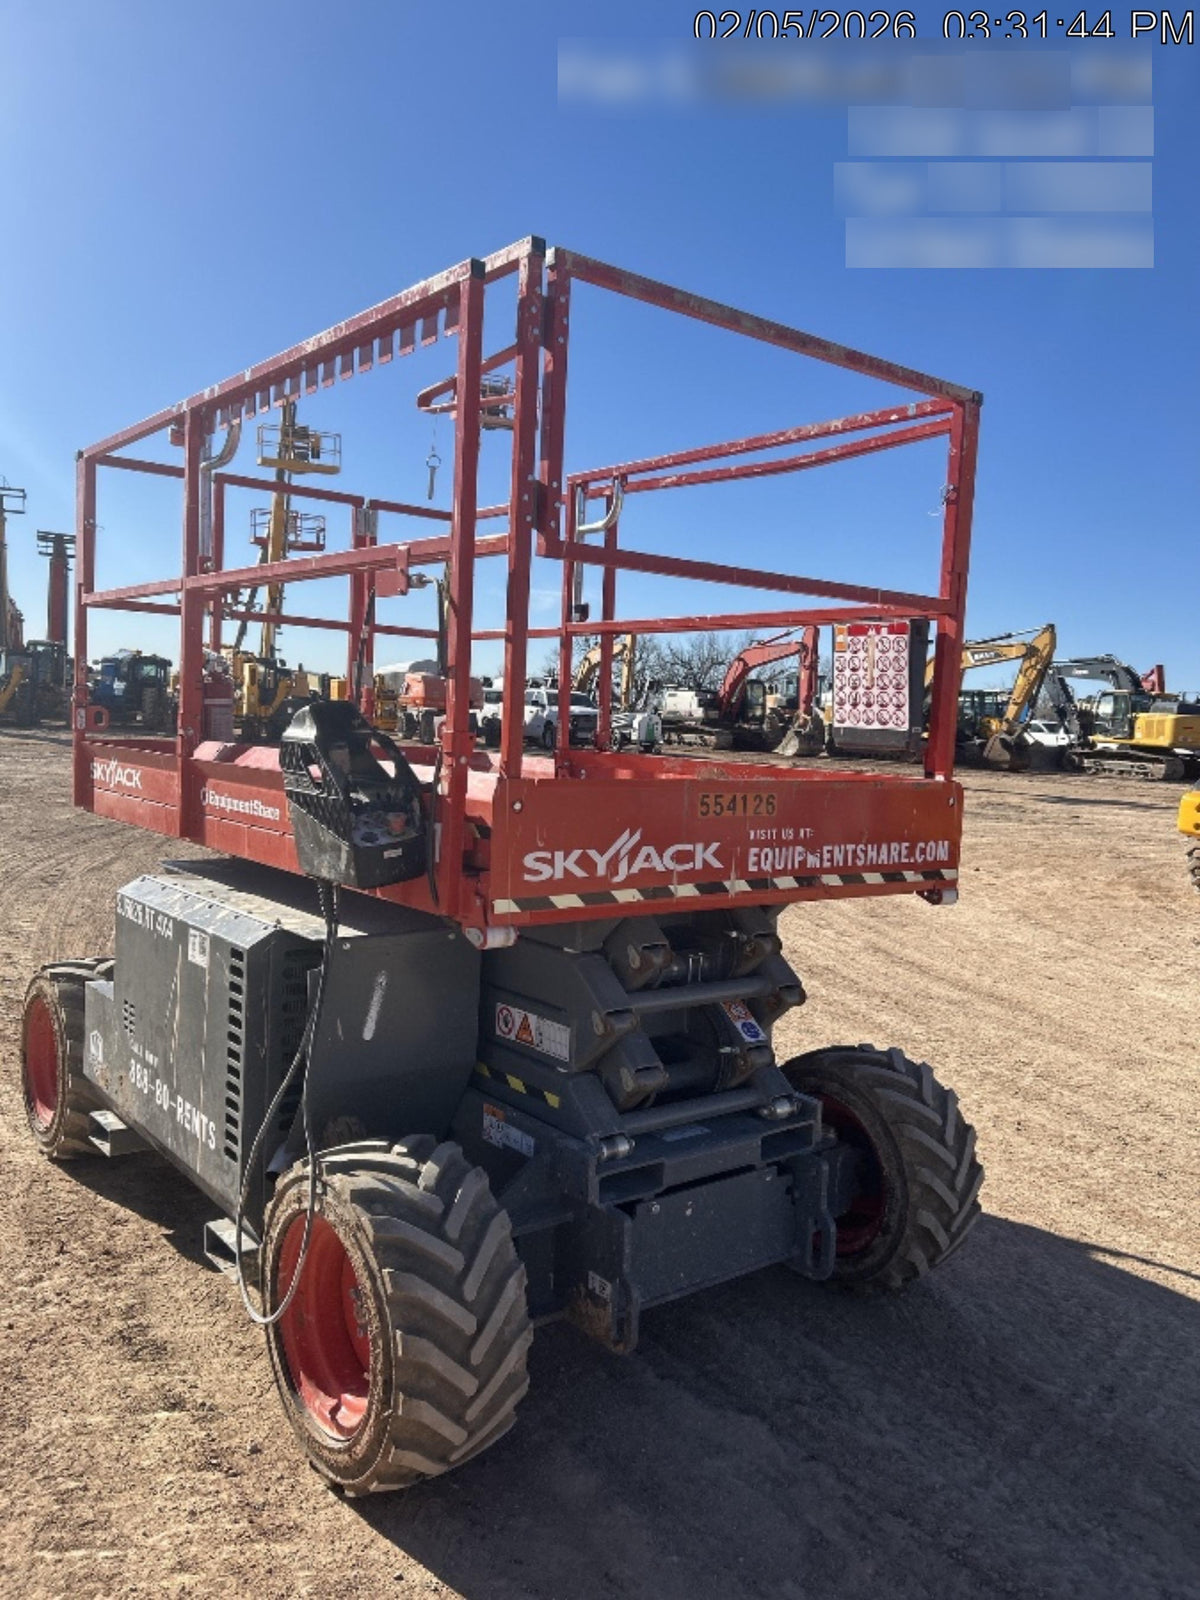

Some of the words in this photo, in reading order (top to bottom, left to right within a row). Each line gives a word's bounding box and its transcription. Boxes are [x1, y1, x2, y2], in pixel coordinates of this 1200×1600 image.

[90, 757, 143, 790] SKYJACK
[699, 793, 776, 817] 554126
[749, 828, 778, 841] VISIT
[781, 827, 795, 841] US
[523, 827, 725, 883] SKYJACK
[748, 840, 950, 872] EQUIPMENTSHARE.COM
